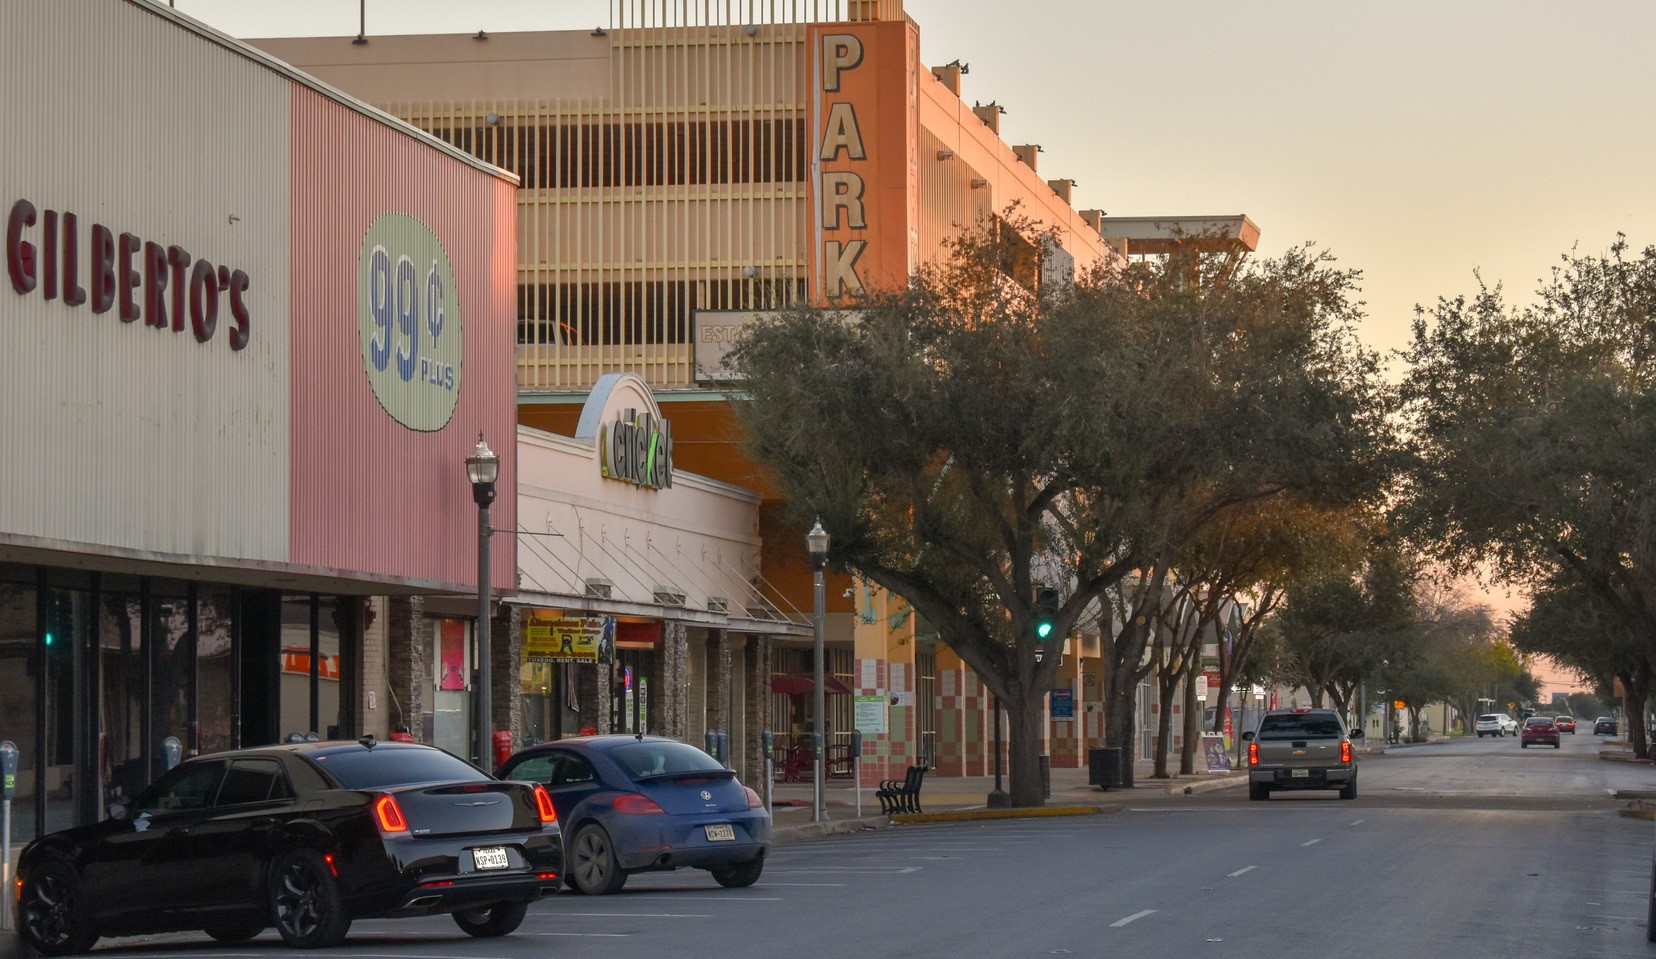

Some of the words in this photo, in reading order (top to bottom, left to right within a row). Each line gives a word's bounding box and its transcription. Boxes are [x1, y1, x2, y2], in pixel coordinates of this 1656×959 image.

[820, 33, 867, 300] PARK
[7, 198, 250, 352] GILBERTO'S
[421, 355, 454, 391] PLUS
